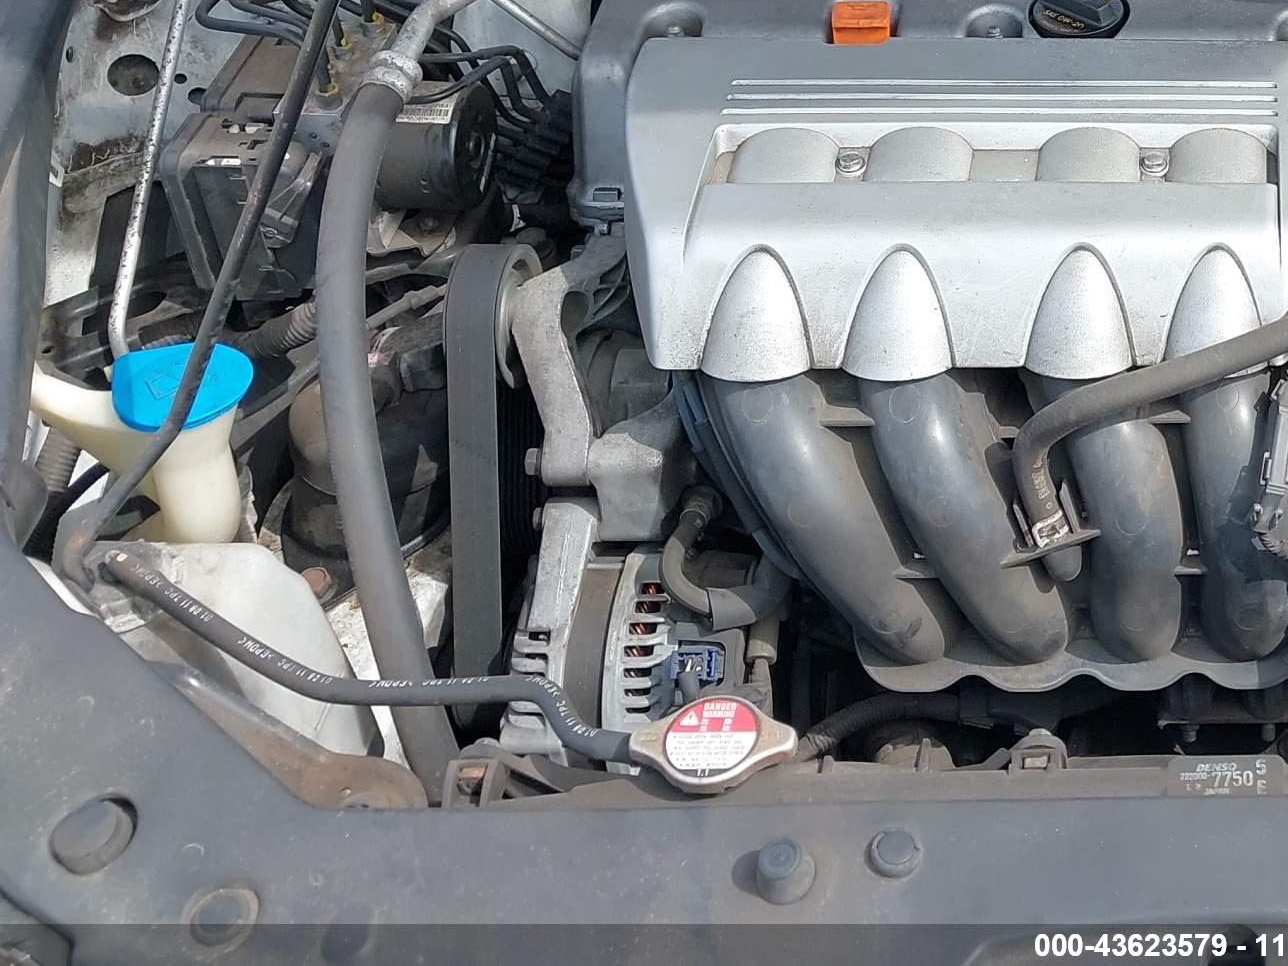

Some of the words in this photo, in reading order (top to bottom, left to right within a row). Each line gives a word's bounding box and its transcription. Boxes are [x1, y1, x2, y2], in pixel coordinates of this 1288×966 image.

[1045, 9, 1059, 19] SAE
[1057, 15, 1085, 30] 0W-20
[703, 701, 737, 711] DANGER
[1195, 762, 1238, 772] DENSO
[697, 768, 710, 777] 1.1
